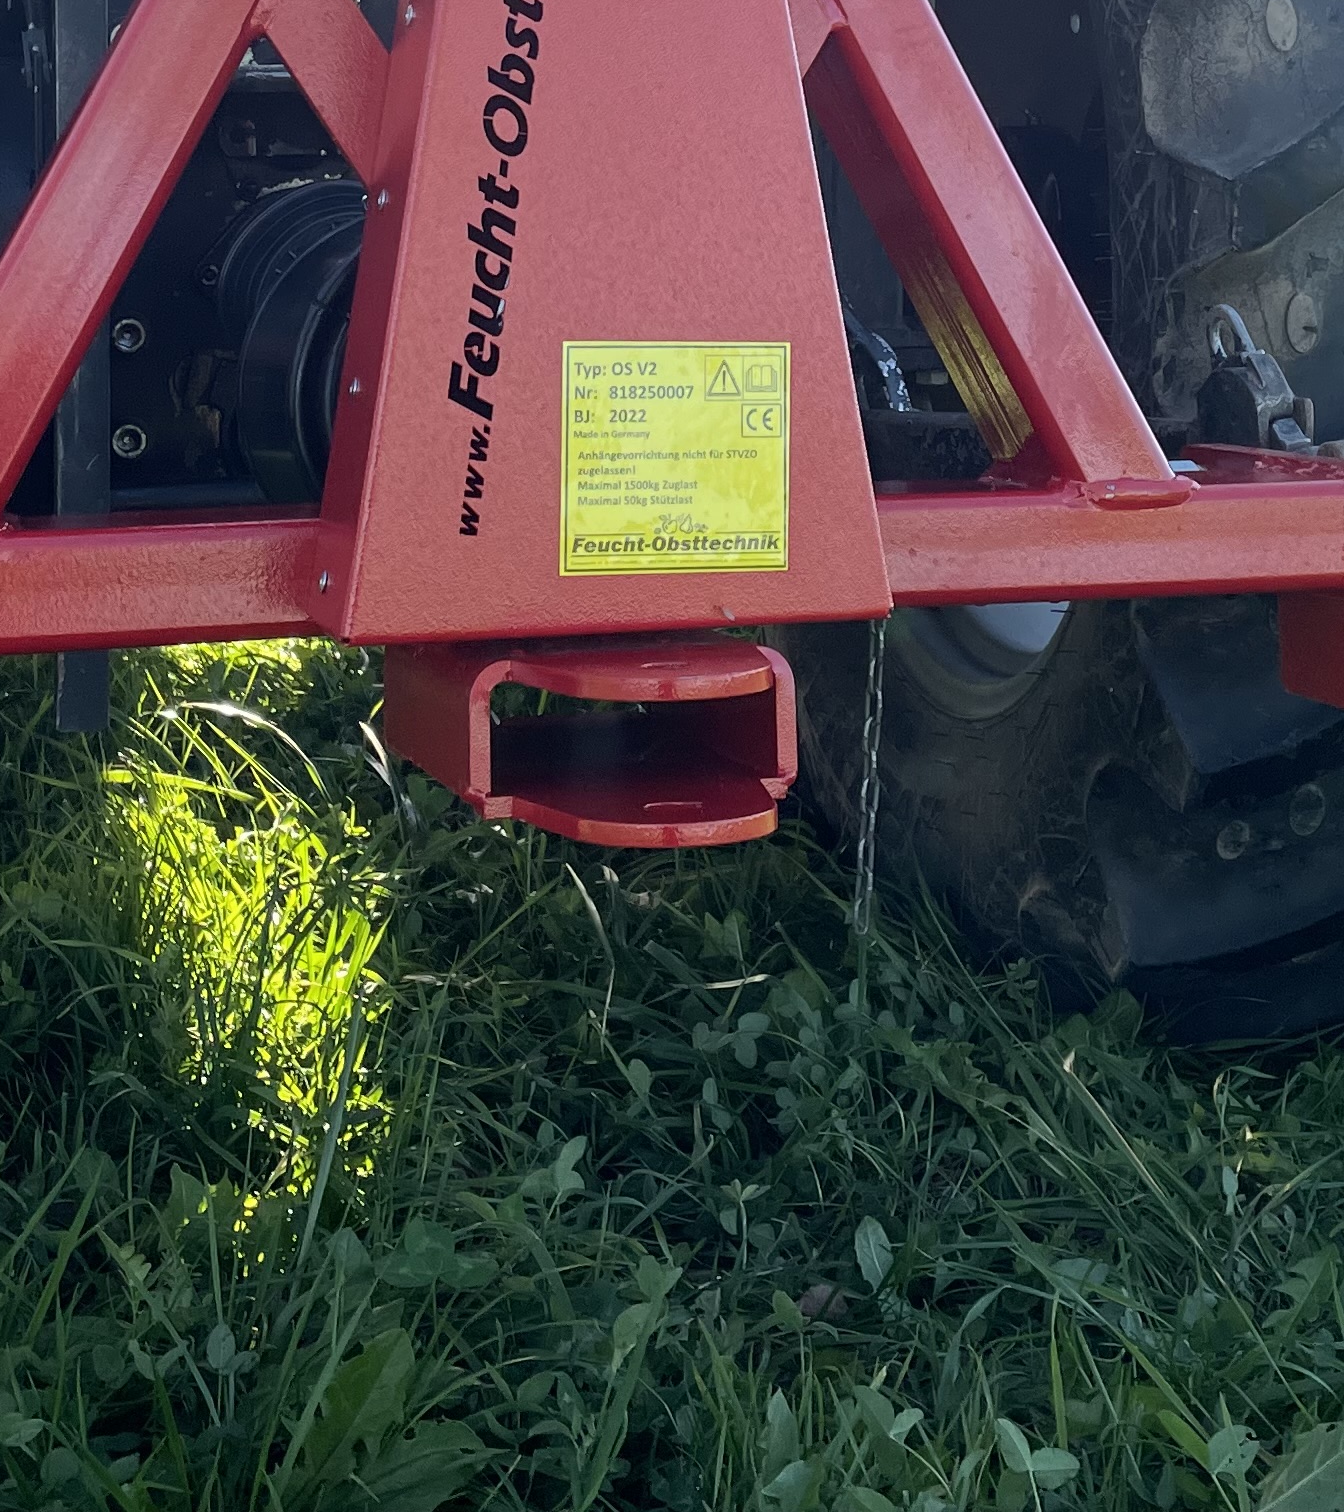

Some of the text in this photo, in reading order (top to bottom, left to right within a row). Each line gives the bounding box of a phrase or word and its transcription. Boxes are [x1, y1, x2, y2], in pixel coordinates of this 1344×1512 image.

[574, 361, 657, 379] Typ: OS V2
[574, 385, 694, 400] Nr: 818250007
[574, 409, 647, 423] BJ: 2022
[573, 430, 650, 439] Made in Germany
[578, 450, 680, 461] Anhängevorrichtung
[682, 450, 706, 459] nicht
[709, 450, 724, 459] für
[578, 479, 698, 491] Maximal 1500kg Zuglast
[578, 496, 621, 505] Maximal
[624, 495, 647, 506] 50kg
[572, 535, 779, 553] Feucht-Obsttechnik
